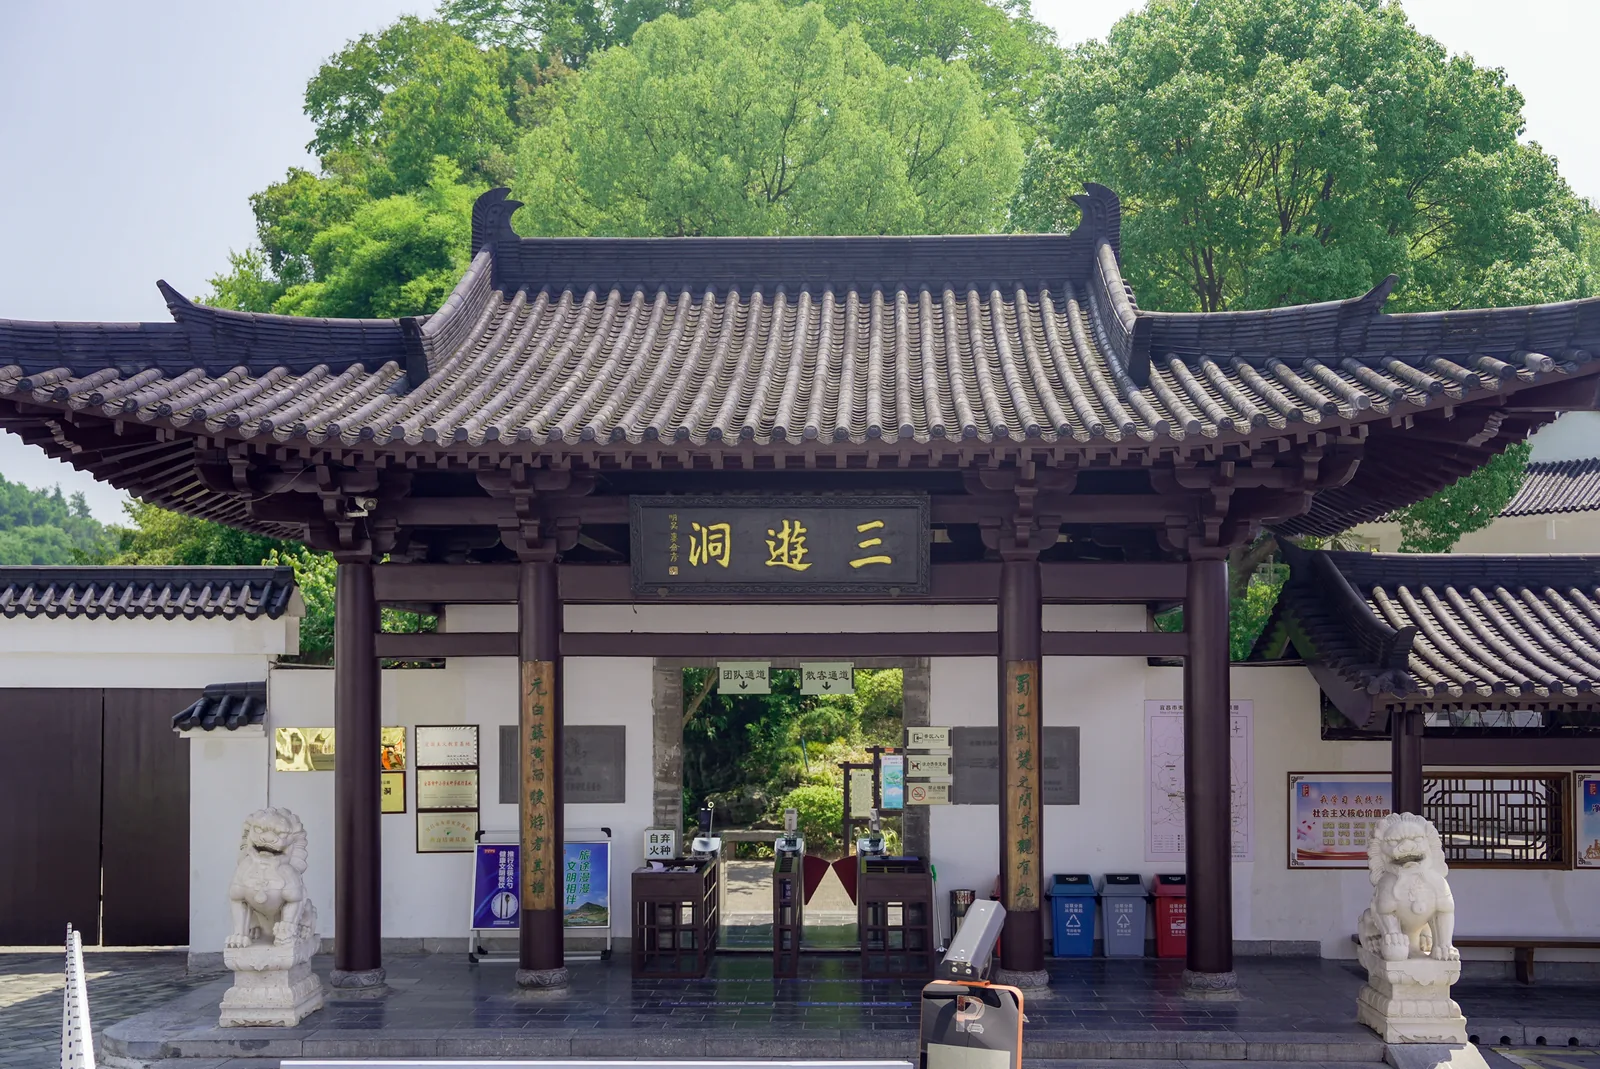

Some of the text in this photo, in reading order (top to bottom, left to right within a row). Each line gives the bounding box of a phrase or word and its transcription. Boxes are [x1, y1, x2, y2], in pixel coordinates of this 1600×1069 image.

[723, 669, 767, 681] 团队通道
[805, 669, 850, 681] 散客通道
[1312, 808, 1390, 818] 社会主义核心价值观
[649, 833, 671, 844] 自弃
[649, 845, 671, 856] 火种
[579, 849, 591, 894] 旅途漫漫
[565, 861, 577, 905] 文明相伴
